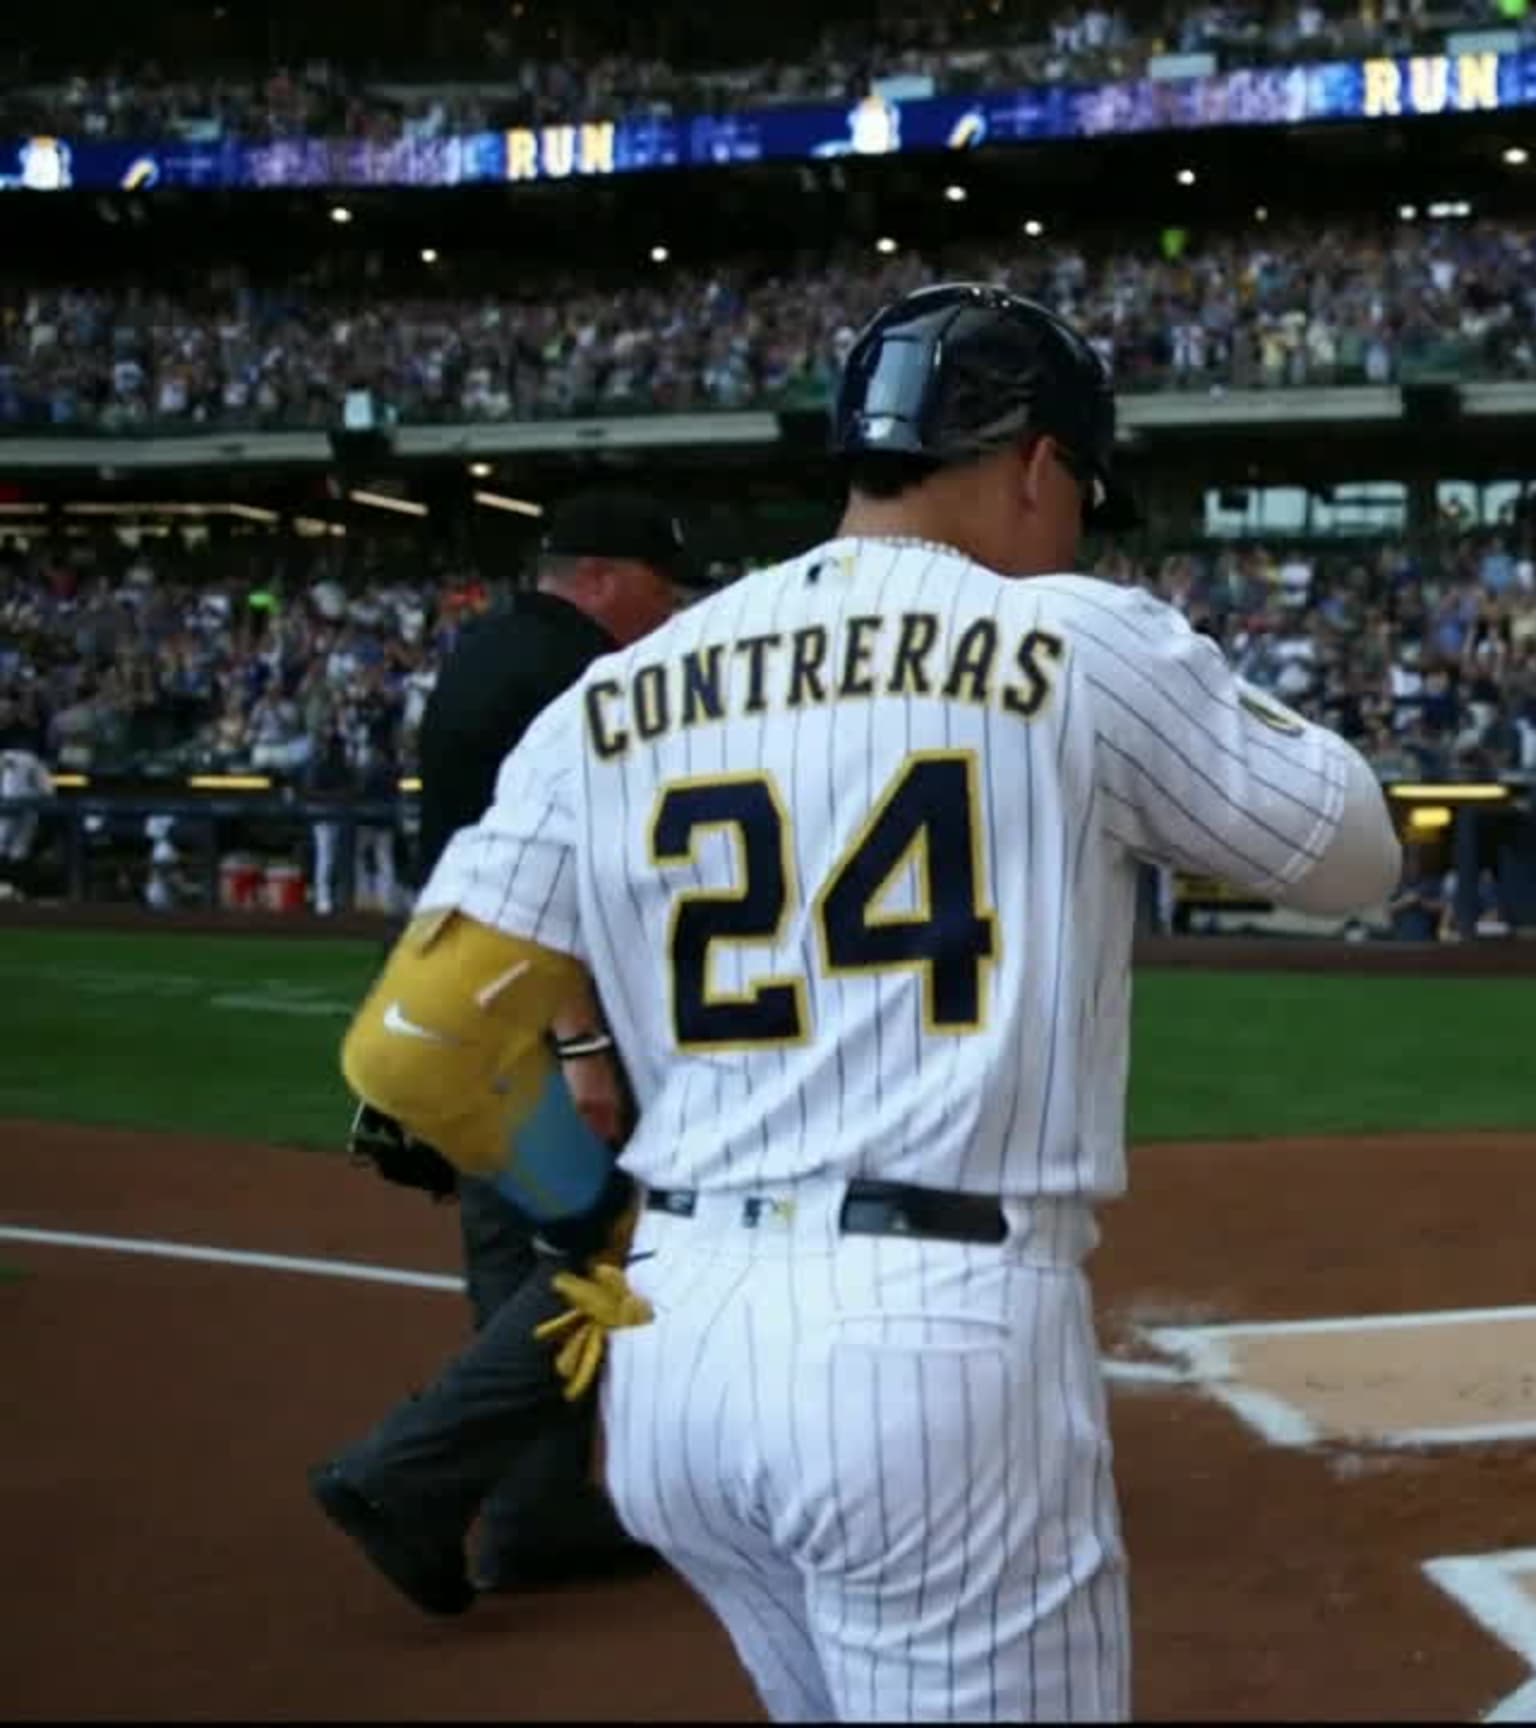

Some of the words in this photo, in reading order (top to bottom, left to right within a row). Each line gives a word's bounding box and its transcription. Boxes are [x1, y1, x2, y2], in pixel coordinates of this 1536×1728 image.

[1362, 52, 1499, 117] RUN
[505, 123, 614, 181] RUN
[584, 611, 1065, 760] CONTRERAS
[649, 749, 1000, 1050] 24
